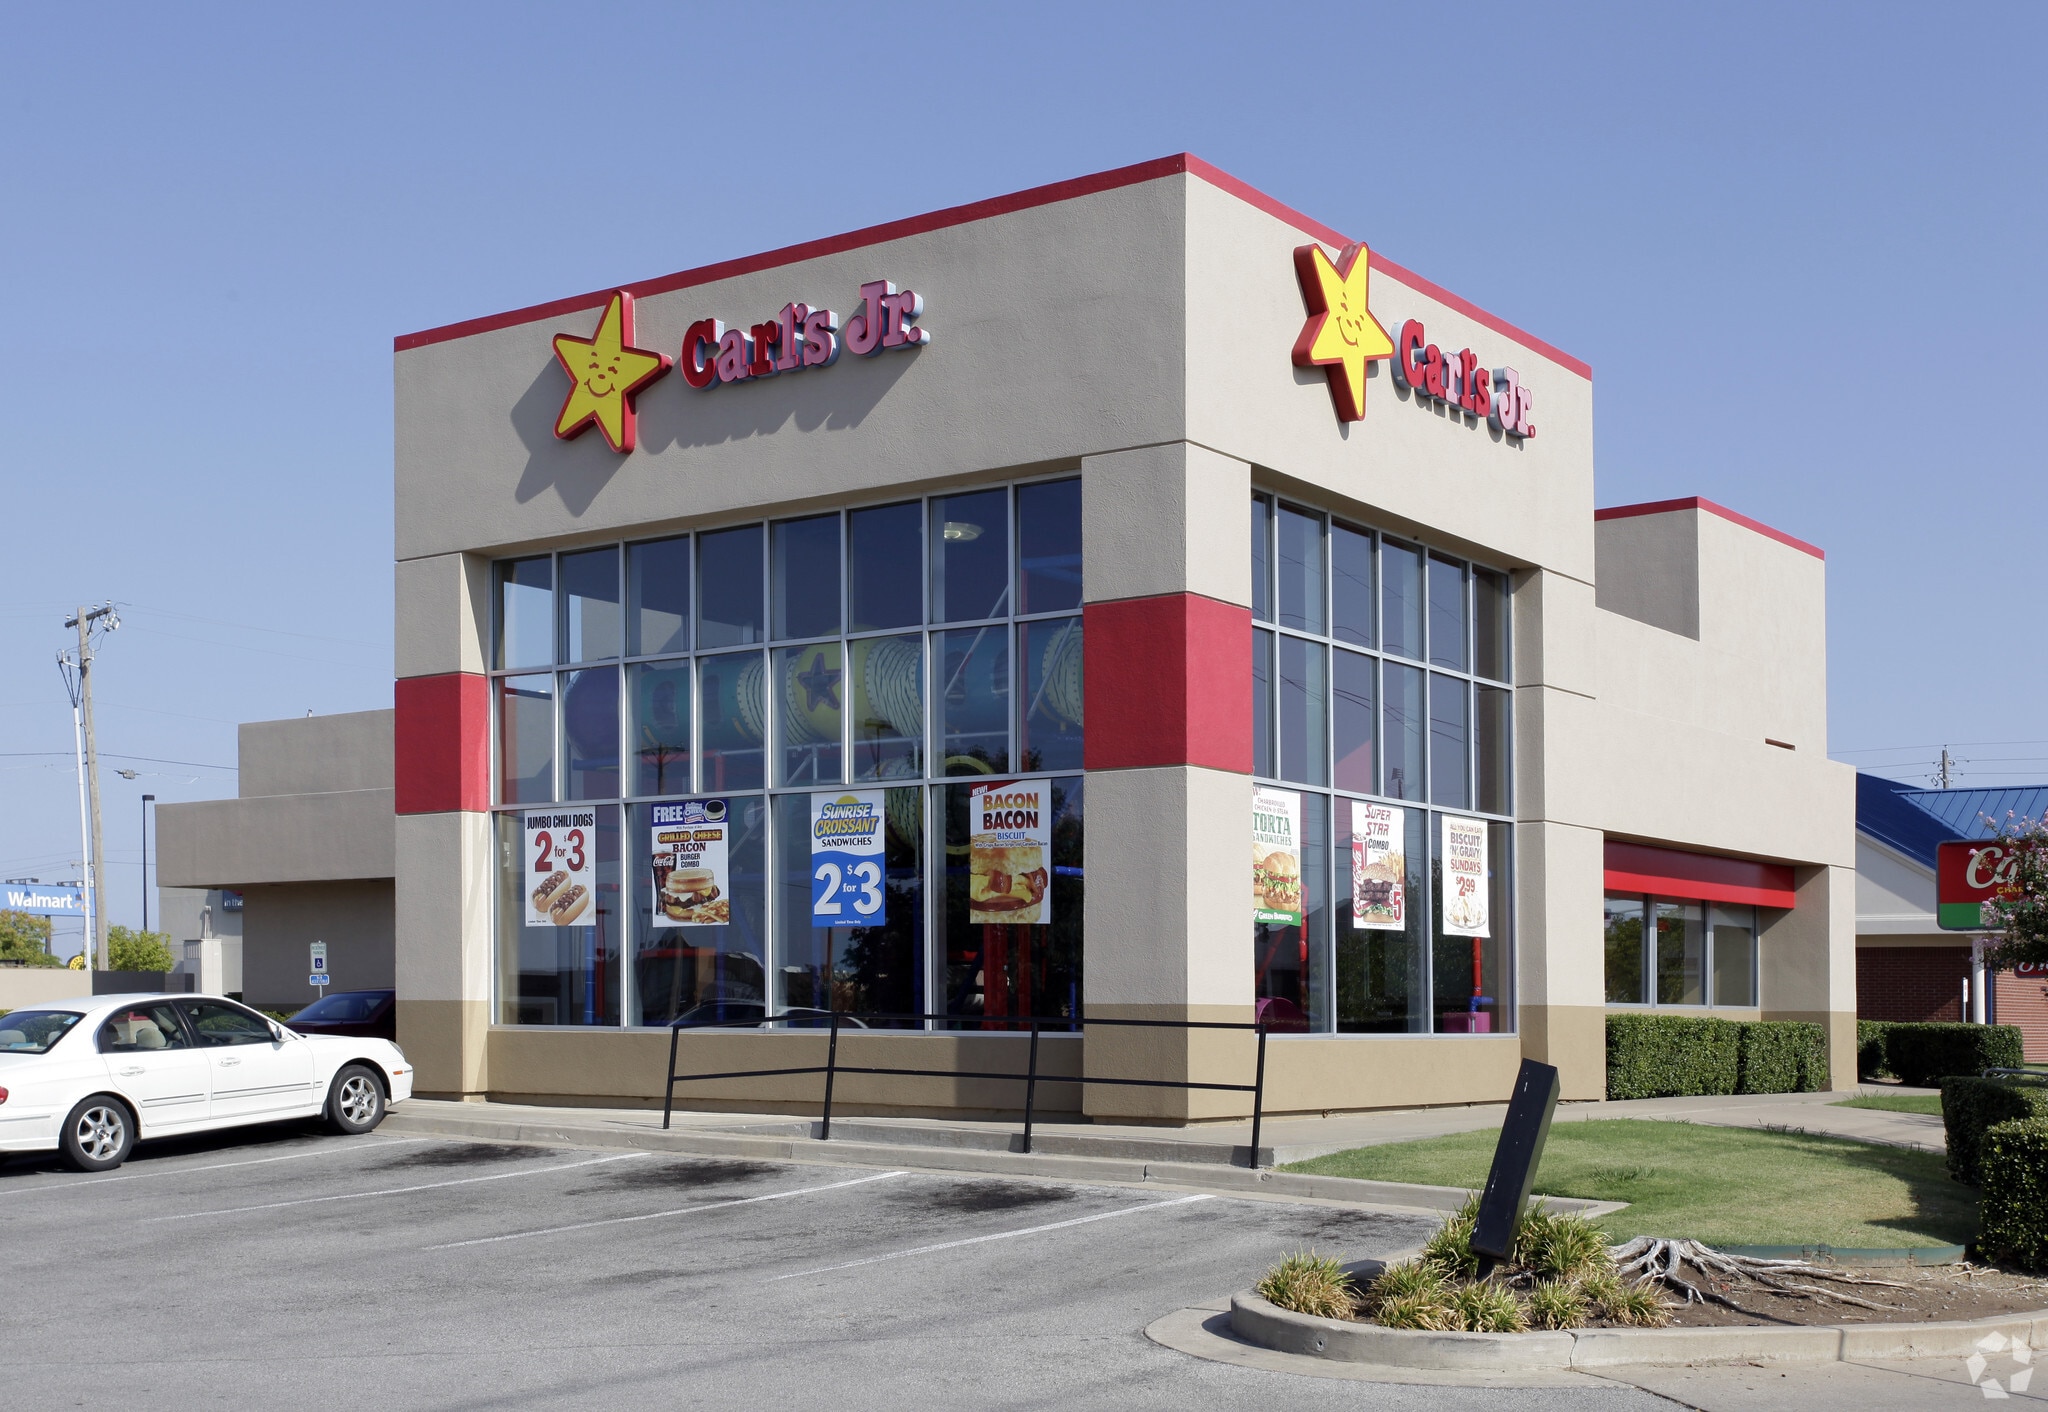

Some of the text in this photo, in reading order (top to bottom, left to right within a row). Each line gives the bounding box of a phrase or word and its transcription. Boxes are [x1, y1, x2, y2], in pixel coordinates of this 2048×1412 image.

[682, 280, 929, 389] Carl's Jr.
[1394, 319, 1536, 438] Carl's Jr.
[972, 785, 988, 796] NEW!
[983, 792, 1039, 811] BACON
[653, 806, 683, 823] FREE
[822, 803, 872, 820] SUNRISE
[1365, 804, 1391, 821] SUPER
[527, 814, 593, 829] JUMBO CHILI DOGS
[815, 818, 879, 838] CROISSANT
[983, 811, 1039, 830] BACON
[1253, 812, 1291, 835] TORTA
[658, 829, 722, 843] GRILLED CHEESE
[997, 832, 1026, 840] BISCUIT
[1366, 822, 1389, 837] STAR
[822, 837, 872, 847] SANDWICHES
[1368, 839, 1389, 850] COMBO
[1450, 832, 1480, 847] BISCUIT
[535, 831, 552, 872] 2
[554, 846, 566, 857] for
[673, 843, 706, 853] BACON
[1459, 846, 1480, 859] GRAVY
[681, 853, 700, 861] BURGER
[1450, 859, 1481, 873] SUNDAYS
[814, 863, 842, 915] 2
[843, 883, 857, 892] for
[8, 891, 72, 909] Walmart
